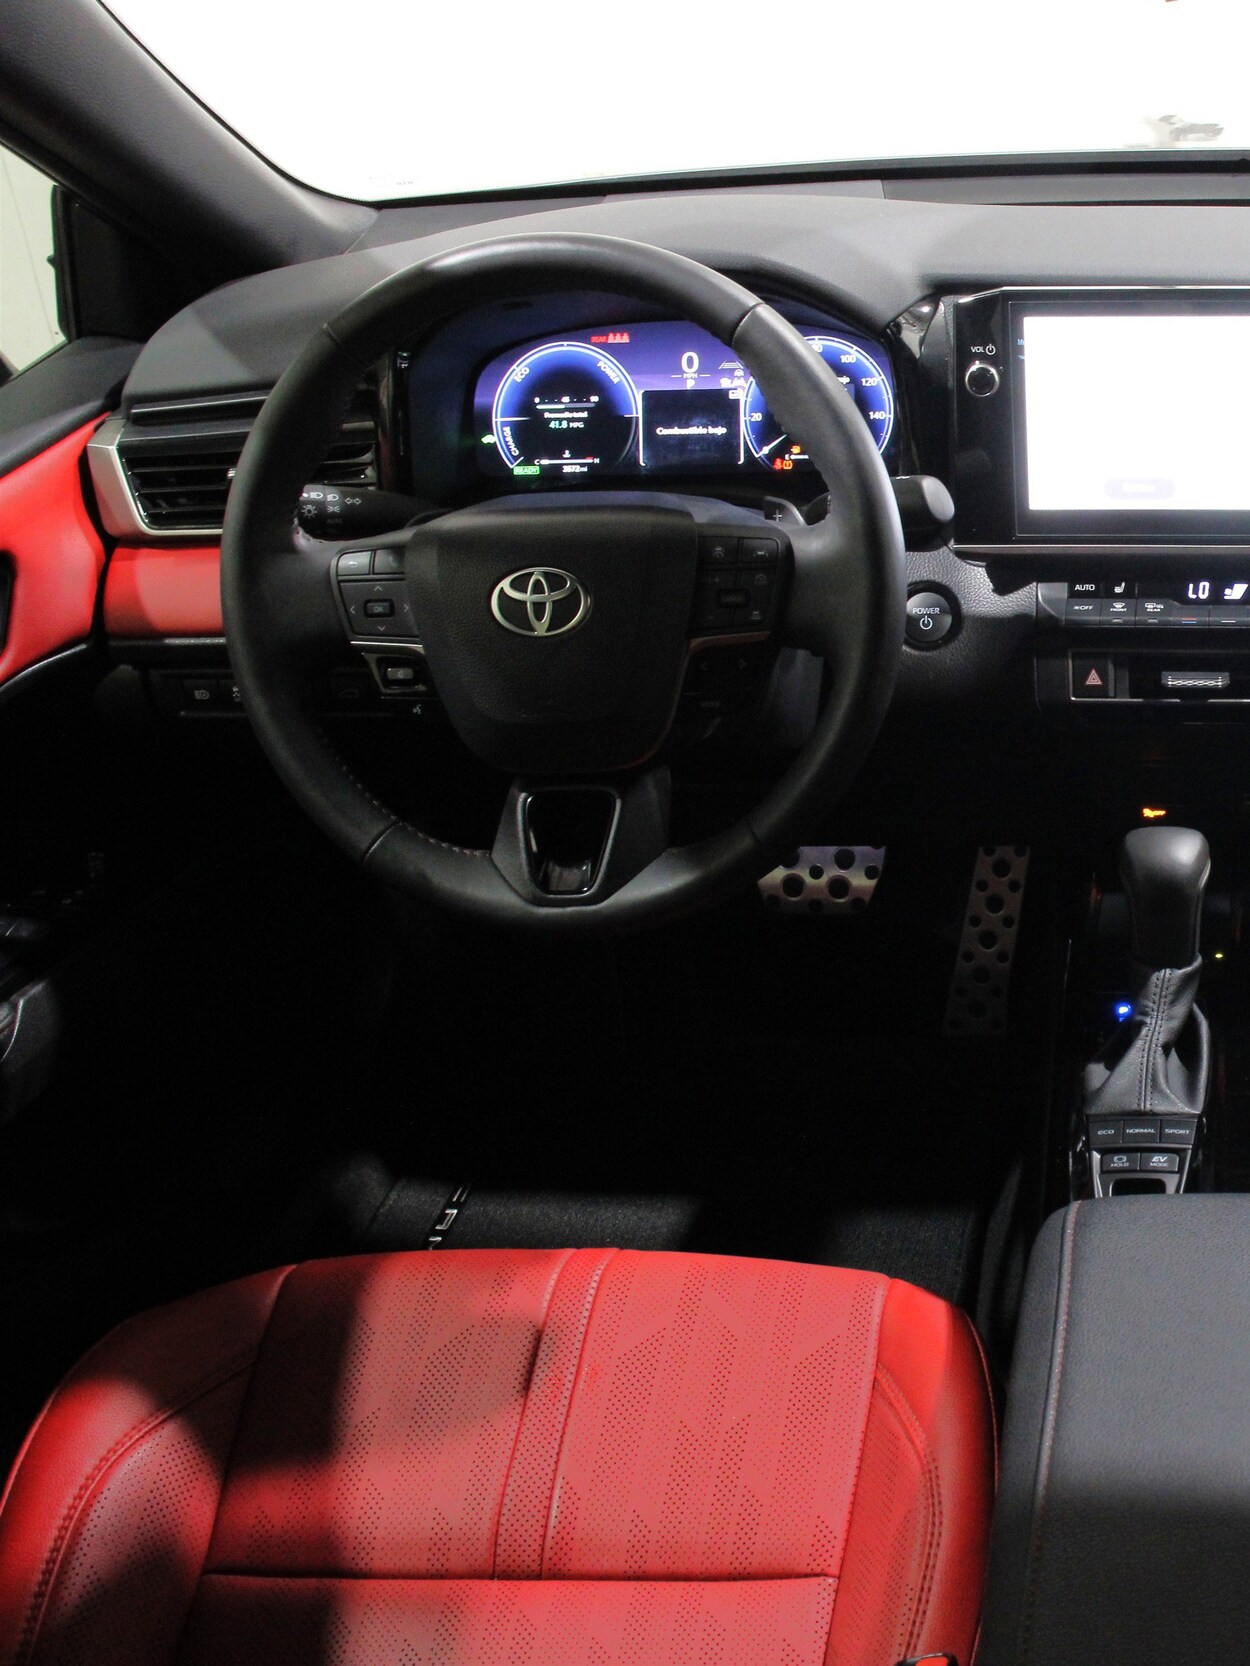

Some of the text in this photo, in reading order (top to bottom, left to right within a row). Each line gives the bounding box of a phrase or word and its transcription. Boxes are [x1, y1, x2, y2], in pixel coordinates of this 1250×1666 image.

[680, 351, 700, 373] 0
[840, 355, 857, 363] 100
[513, 366, 530, 383] ECO
[596, 360, 621, 384] POWER
[686, 379, 696, 390] P
[861, 378, 878, 386] 120
[750, 412, 763, 422] 20
[868, 411, 886, 419] 140
[549, 420, 568, 429] 41.8
[656, 426, 728, 436] Combustible bajo
[503, 426, 520, 457] CHARGE
[514, 467, 539, 475] READY
[1187, 581, 1210, 600] LO
[373, 605, 385, 613] OK
[912, 607, 941, 615] POWER
